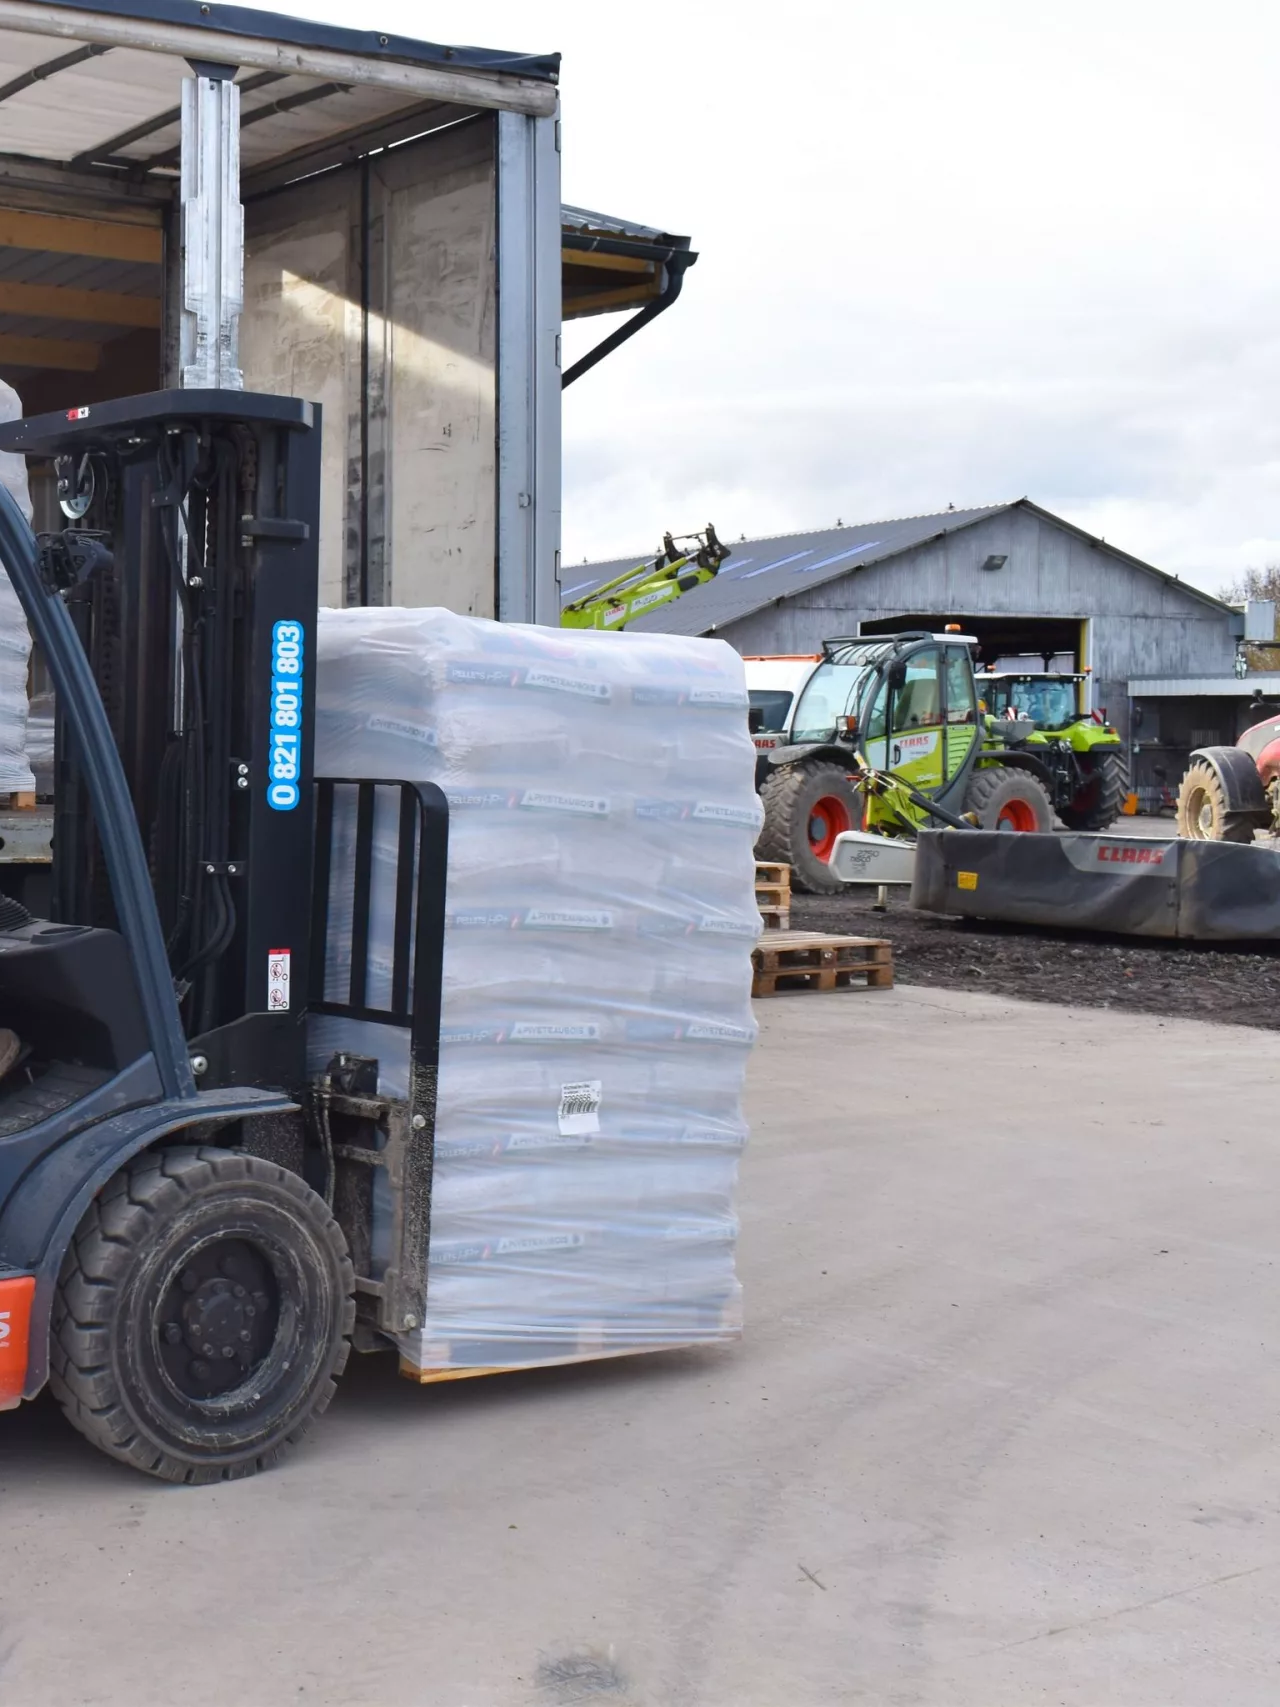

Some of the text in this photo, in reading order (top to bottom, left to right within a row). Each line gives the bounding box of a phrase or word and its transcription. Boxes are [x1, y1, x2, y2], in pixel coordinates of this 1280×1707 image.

[272, 625, 300, 805] 0 821 801 803
[754, 739, 776, 749] AAS
[899, 736, 929, 748] CLAAS
[1097, 845, 1165, 865] CLAAS
